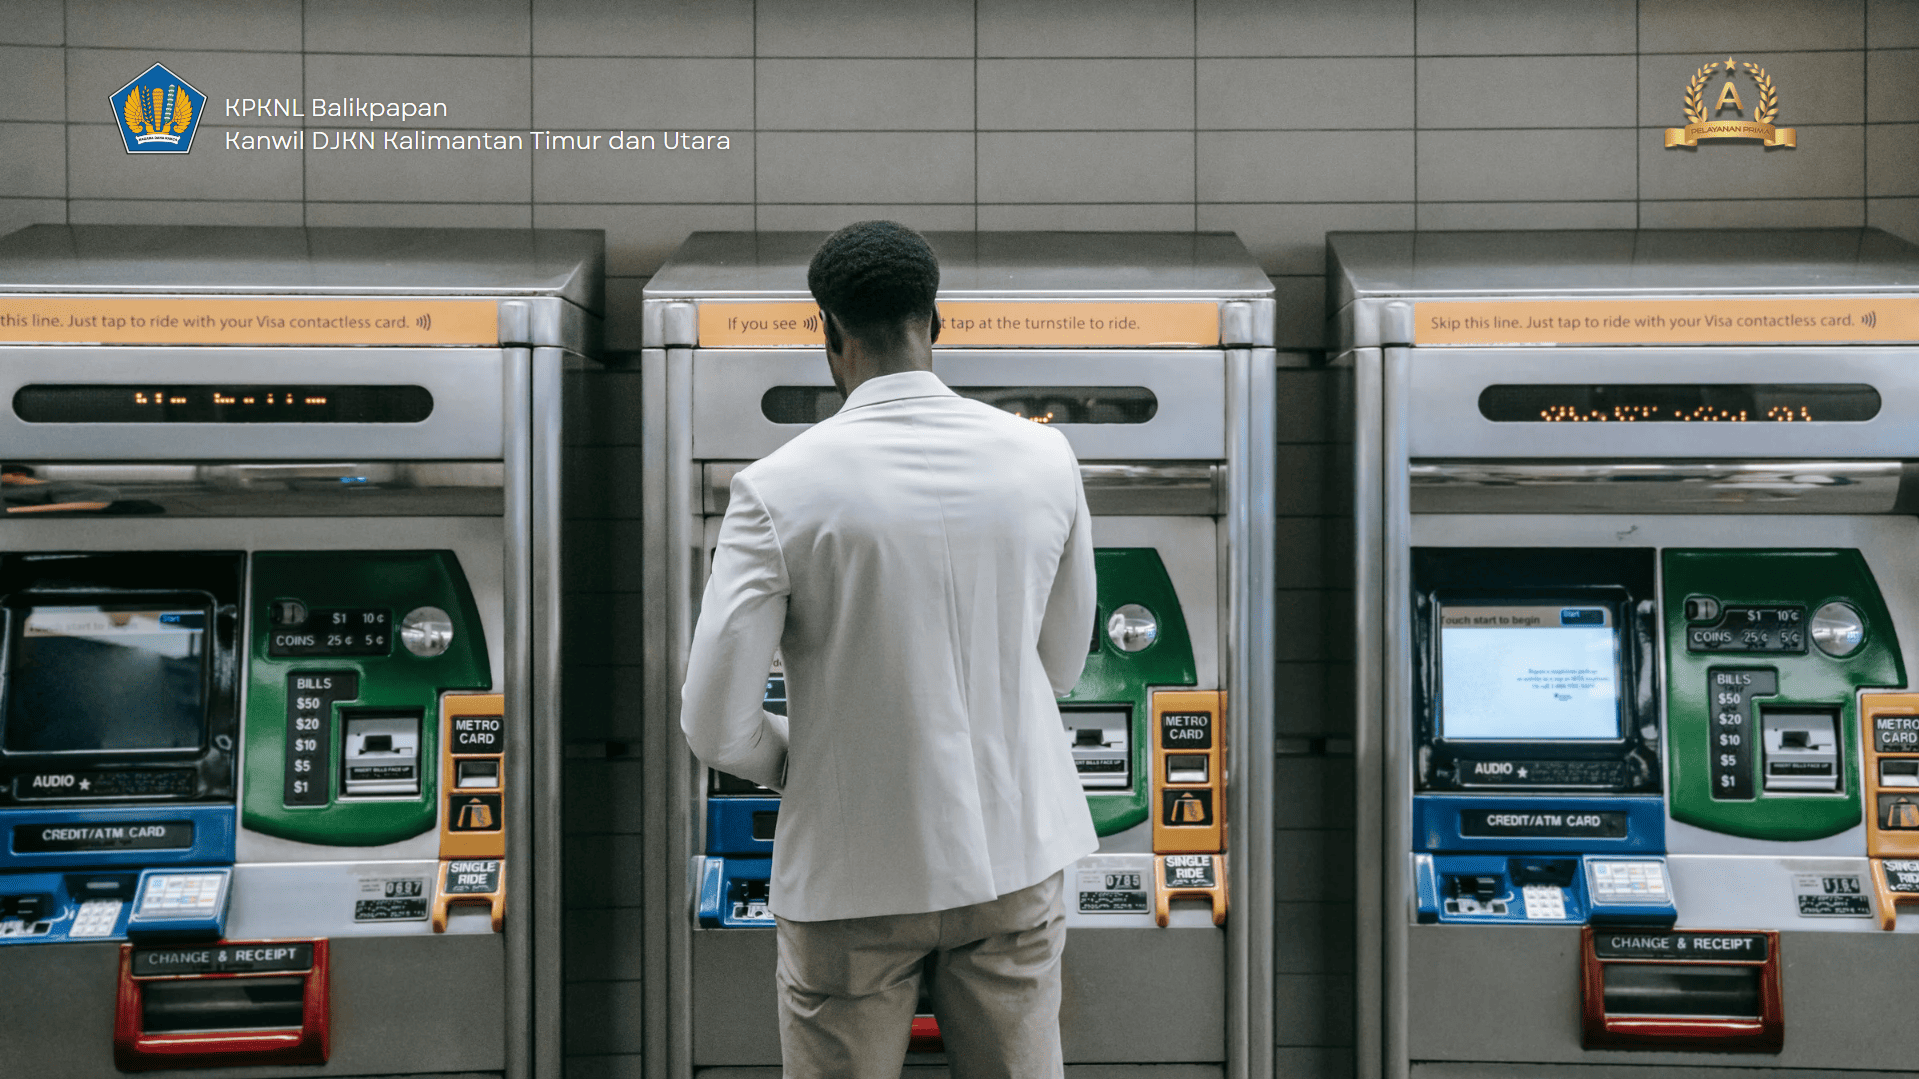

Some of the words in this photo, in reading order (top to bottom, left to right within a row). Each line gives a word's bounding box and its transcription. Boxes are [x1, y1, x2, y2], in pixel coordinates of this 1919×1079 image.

[1, 314, 27, 327] this
[33, 314, 63, 327] line.
[67, 315, 97, 327] Just
[102, 316, 126, 330] tap
[131, 316, 146, 327] to
[151, 315, 179, 328] ride
[183, 315, 215, 328] with
[220, 318, 253, 331] your
[256, 316, 285, 328] Visa
[290, 315, 371, 328] contactless
[375, 316, 409, 328] card.
[728, 317, 737, 330] If
[741, 320, 768, 333] you
[773, 320, 797, 329] see
[951, 318, 975, 331] tap
[979, 318, 992, 329] at
[997, 316, 1021, 329] the
[1025, 316, 1086, 329] turnstile
[1090, 318, 1105, 329] to
[1109, 316, 1140, 329] ride.
[1431, 316, 1461, 331] Skip
[1465, 316, 1490, 328] this
[1494, 316, 1523, 328] line.
[1526, 316, 1554, 328] Just
[1558, 317, 1581, 330] tap
[1585, 317, 1600, 328] to
[1603, 315, 1630, 328] ride
[1634, 315, 1665, 327] with
[1670, 318, 1701, 330] your
[1704, 315, 1732, 327] Visa
[1737, 314, 1816, 327] contactless
[1821, 314, 1855, 326] card.
[1439, 616, 1471, 625] Touch
[1474, 616, 1497, 625] start
[1499, 616, 1510, 625] to
[1512, 616, 1540, 627] begin
[275, 634, 316, 647] COINS
[1694, 631, 1732, 643] COINS
[297, 677, 332, 690] BILLS
[1717, 674, 1751, 685] BILLS
[296, 697, 320, 710] $50
[1718, 693, 1740, 705] $50
[295, 717, 319, 731] $20
[1165, 716, 1208, 727] METRO
[1719, 713, 1741, 725] $20
[1877, 718, 1919, 730] METRO
[456, 720, 500, 731] METRO
[459, 733, 495, 744] CARD
[1169, 729, 1204, 740] CARD
[1720, 734, 1740, 746] $10
[1882, 732, 1918, 743] CARD
[294, 738, 317, 752] $10
[294, 759, 311, 772] $5
[1720, 754, 1736, 766] $5
[1475, 762, 1513, 774] AUDIO
[32, 775, 75, 788] AUDIO
[293, 780, 309, 794] $1
[1721, 775, 1735, 787] $1
[1487, 815, 1562, 826] CREDIT/ATM
[1567, 815, 1601, 827] CARD
[42, 828, 124, 841] CREDIT/ATM
[128, 826, 166, 838] CARD
[450, 862, 496, 873] SINGLE
[1166, 856, 1210, 867] SINGLE
[1886, 861, 1919, 871] SING
[457, 873, 489, 885] RIDE
[1176, 868, 1204, 879] RIDE
[1898, 873, 1919, 884] RID
[386, 881, 422, 894] 0697
[1106, 876, 1139, 888] 0785
[1611, 937, 1670, 949] CHANGE
[1677, 937, 1687, 950] &
[1693, 938, 1753, 950] RECEIPT
[149, 952, 210, 965] CHANGE
[218, 950, 228, 963] &
[235, 948, 297, 962] RECEIPT
